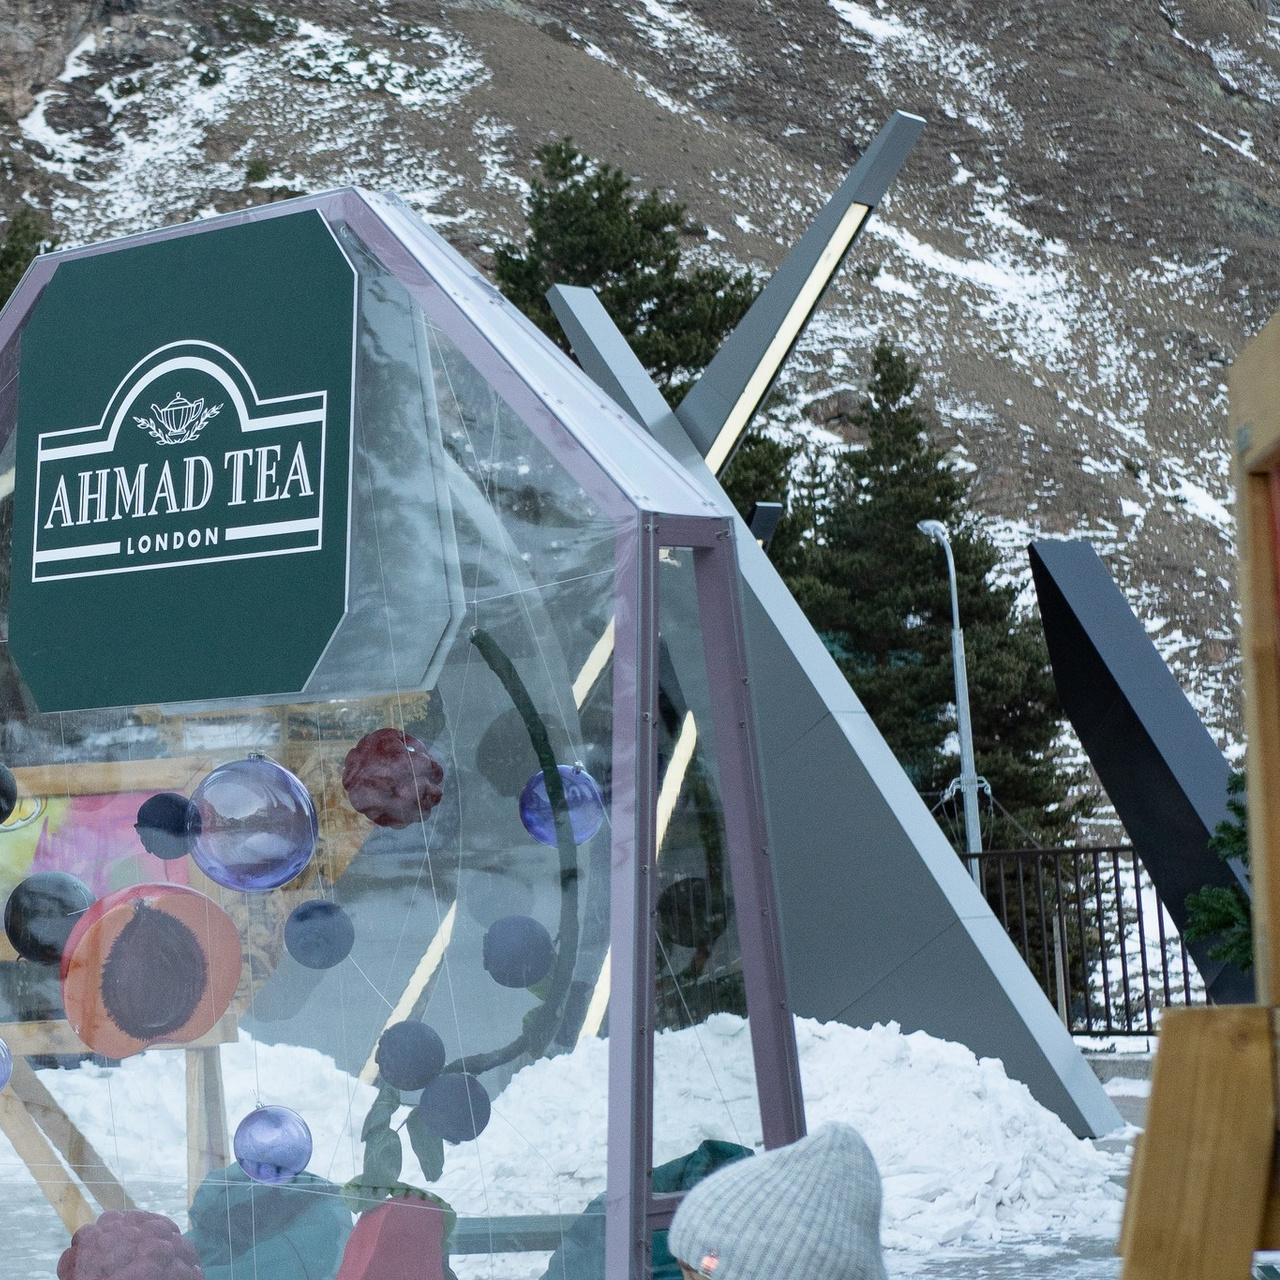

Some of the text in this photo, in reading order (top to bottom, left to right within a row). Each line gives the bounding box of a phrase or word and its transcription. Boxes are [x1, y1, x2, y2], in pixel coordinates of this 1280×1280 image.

[44, 441, 314, 529] AHMAD TEA
[127, 527, 219, 555] LONDON
